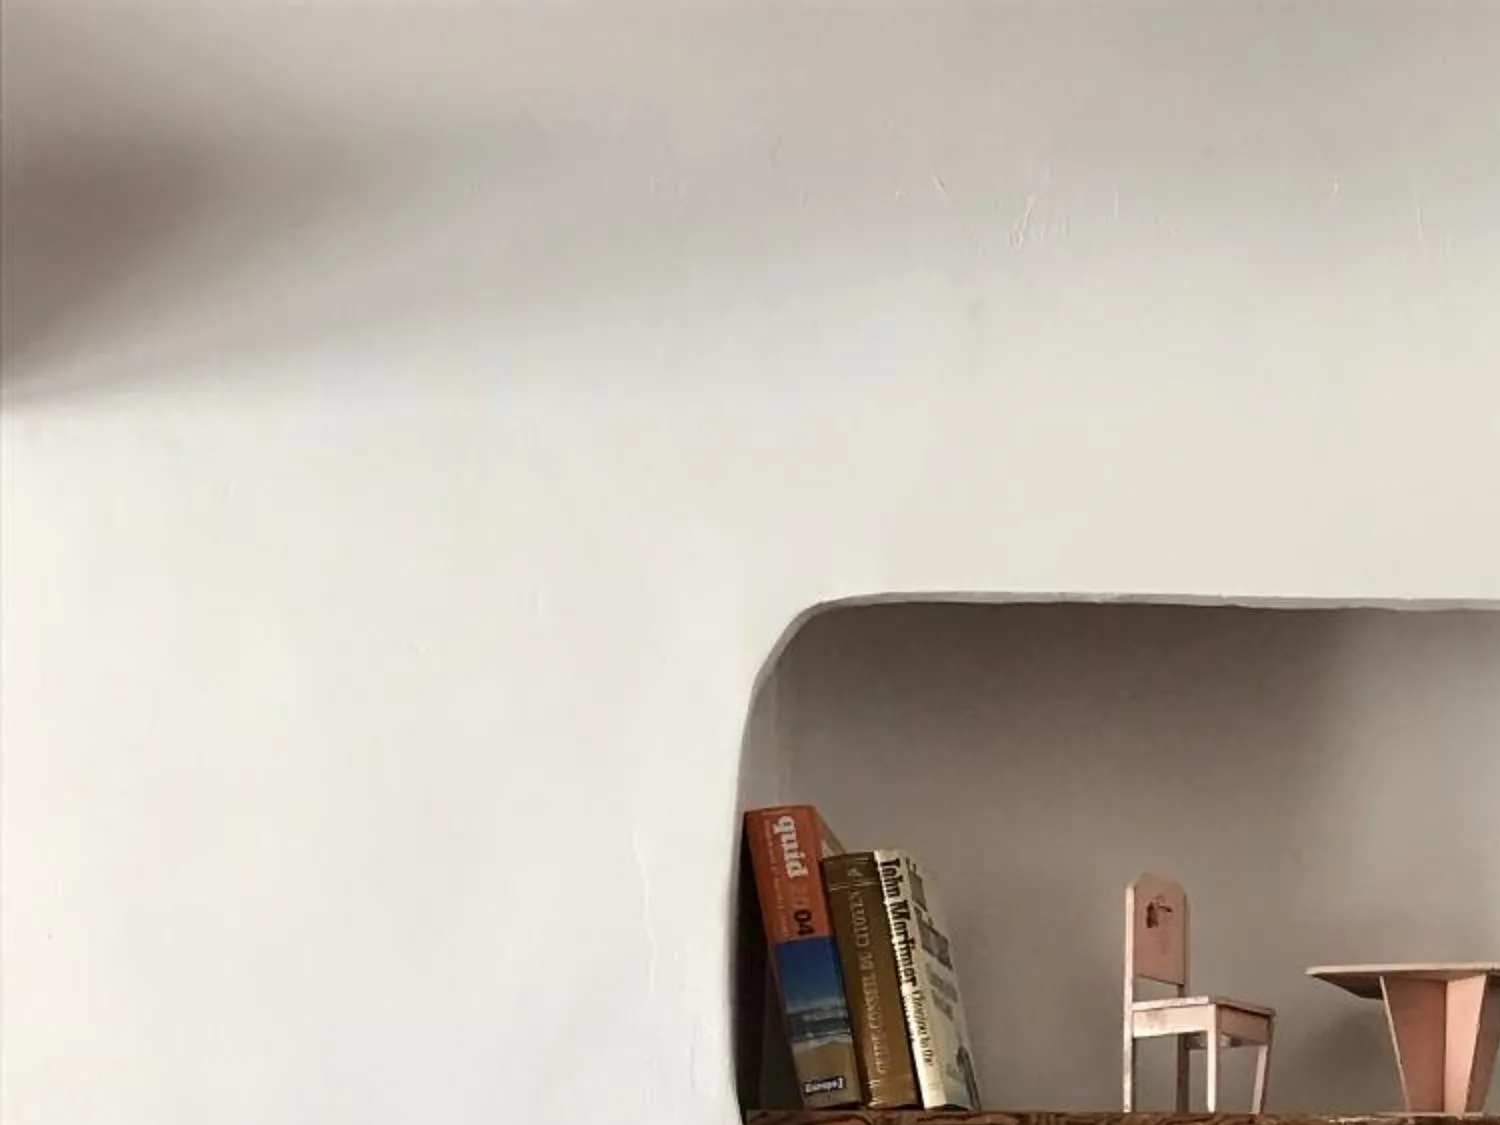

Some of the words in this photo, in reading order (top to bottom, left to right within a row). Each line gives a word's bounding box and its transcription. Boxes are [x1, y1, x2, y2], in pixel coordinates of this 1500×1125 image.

[772, 815, 808, 879] quid
[880, 858, 903, 898] John
[890, 899, 917, 987] Mortimer
